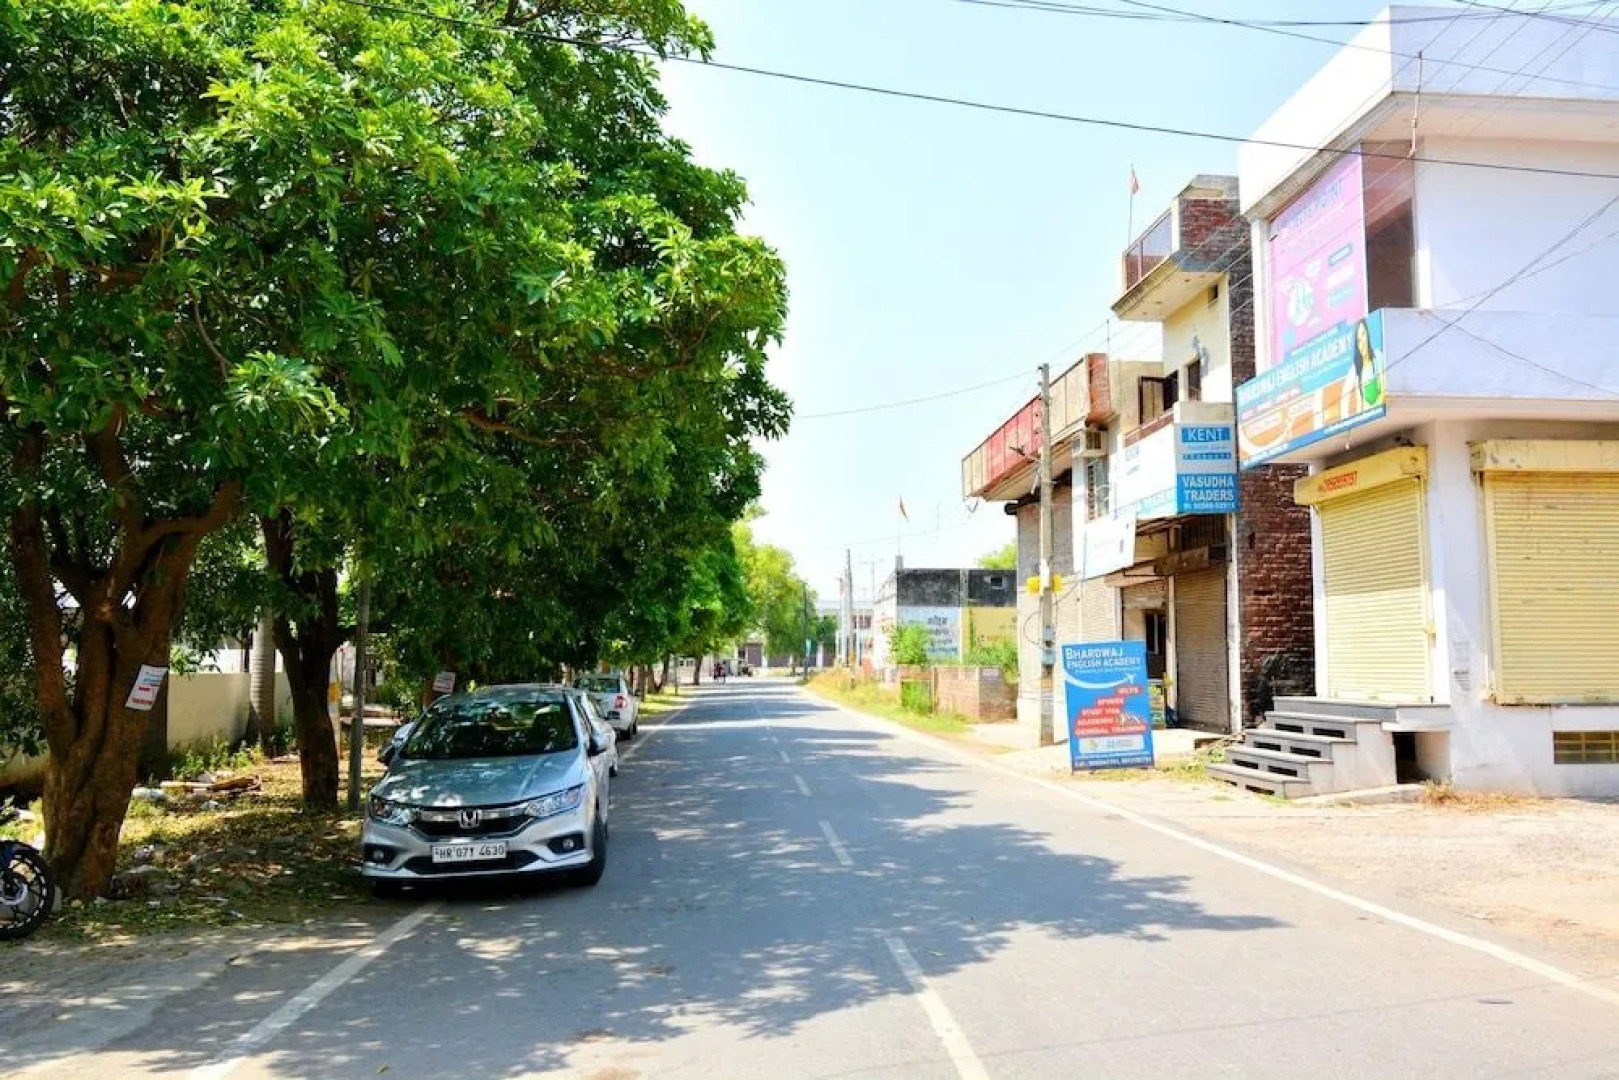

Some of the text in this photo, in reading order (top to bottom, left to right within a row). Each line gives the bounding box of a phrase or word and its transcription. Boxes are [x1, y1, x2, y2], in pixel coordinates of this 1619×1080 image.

[1187, 428, 1224, 441] KENT
[1181, 475, 1235, 488] VASUDHA
[1183, 489, 1235, 502] TRADERS
[1064, 647, 1123, 660] BHARDWAJ
[1066, 656, 1141, 670] ENGLISH ACADEMY
